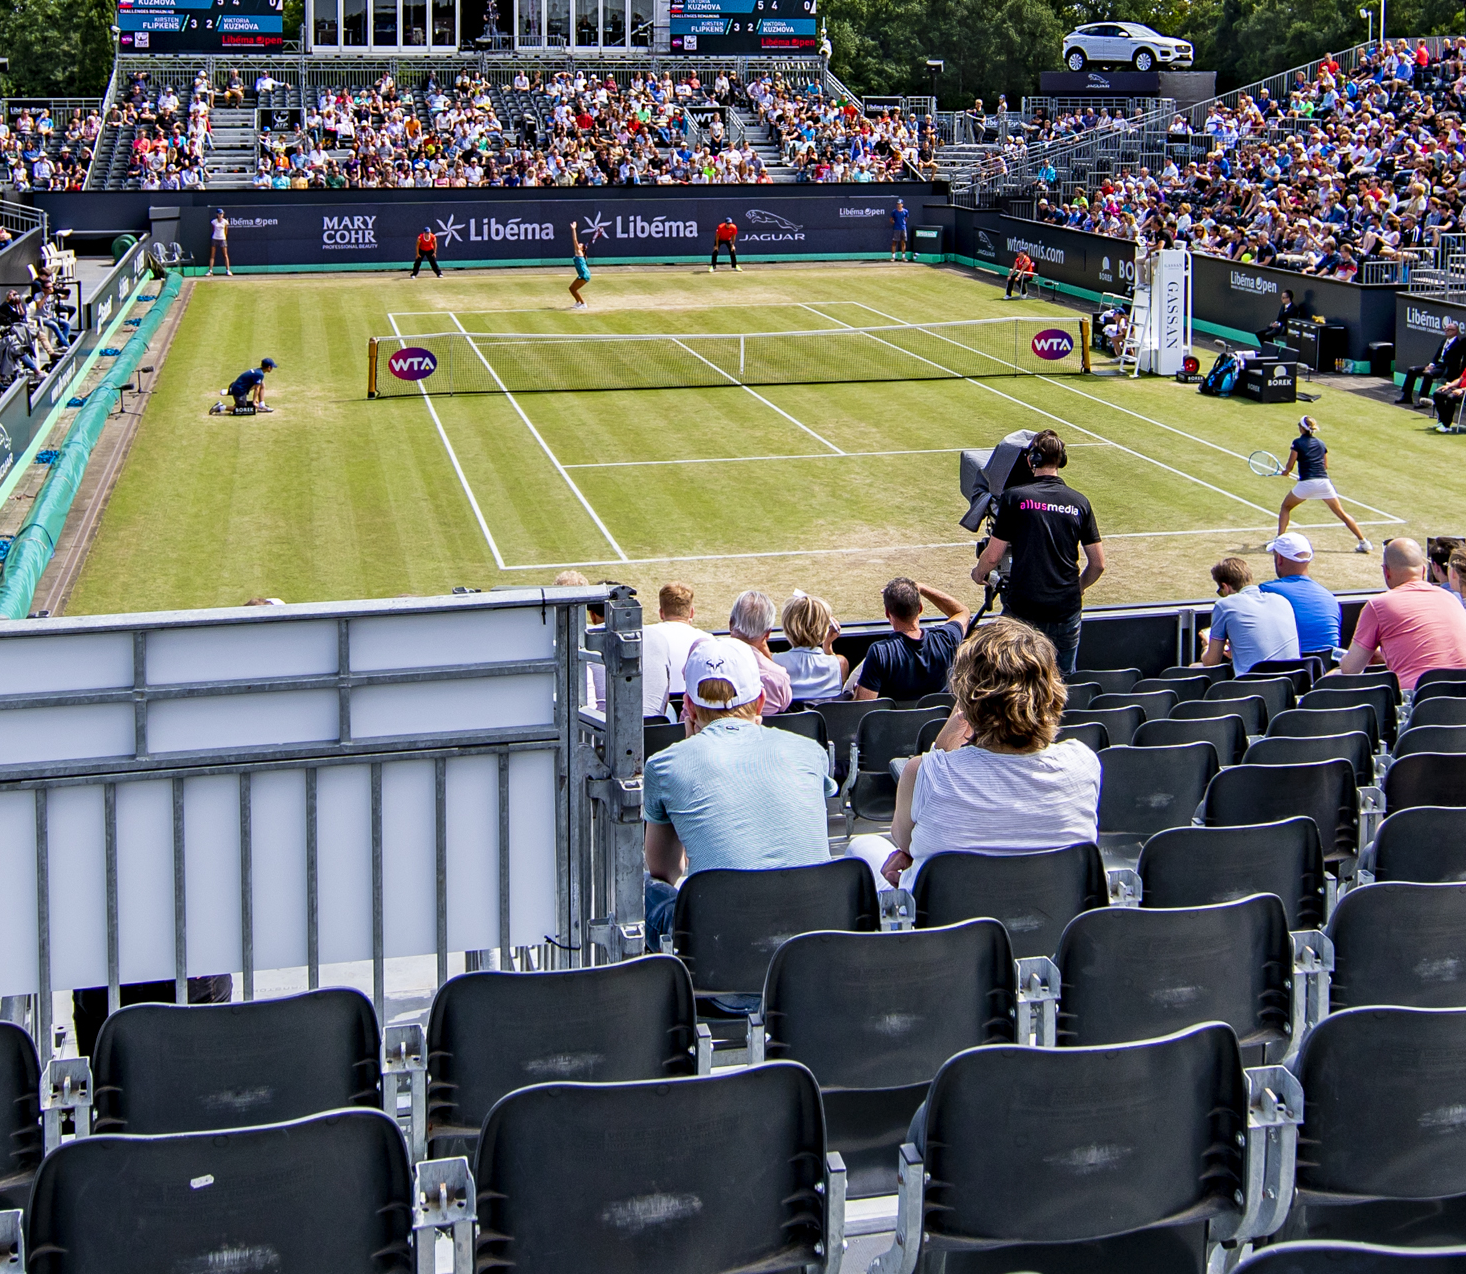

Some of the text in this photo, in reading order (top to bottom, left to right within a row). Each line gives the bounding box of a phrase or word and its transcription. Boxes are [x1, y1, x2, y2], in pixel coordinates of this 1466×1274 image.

[758, 1, 764, 10] 5
[771, 1, 778, 10] 4
[191, 19, 198, 29] 3
[206, 19, 213, 29] 2
[734, 23, 740, 32] 3
[747, 23, 753, 32] 2
[222, 35, 282, 46] Libéma Open
[761, 38, 815, 48] Libéma Open
[693, 113, 716, 123] WT
[839, 207, 885, 218] Libéma Open
[255, 217, 278, 227] Open
[323, 216, 377, 230] MARY
[616, 215, 698, 239] Libéma
[470, 218, 555, 242] Libéma
[323, 230, 377, 244] COHR
[739, 233, 805, 242] JAGUAR
[977, 248, 995, 258] JAGUAR
[1006, 236, 1065, 265] wtatennis.com
[1099, 272, 1113, 282] BOREK
[1231, 270, 1254, 289] Libéma
[1255, 276, 1277, 294] Open
[1166, 281, 1179, 349] GASSAN
[1407, 307, 1441, 329] Libéma
[1034, 338, 1071, 351] WTA
[391, 357, 435, 372] WTA
[1020, 499, 1079, 516] allusmedia
